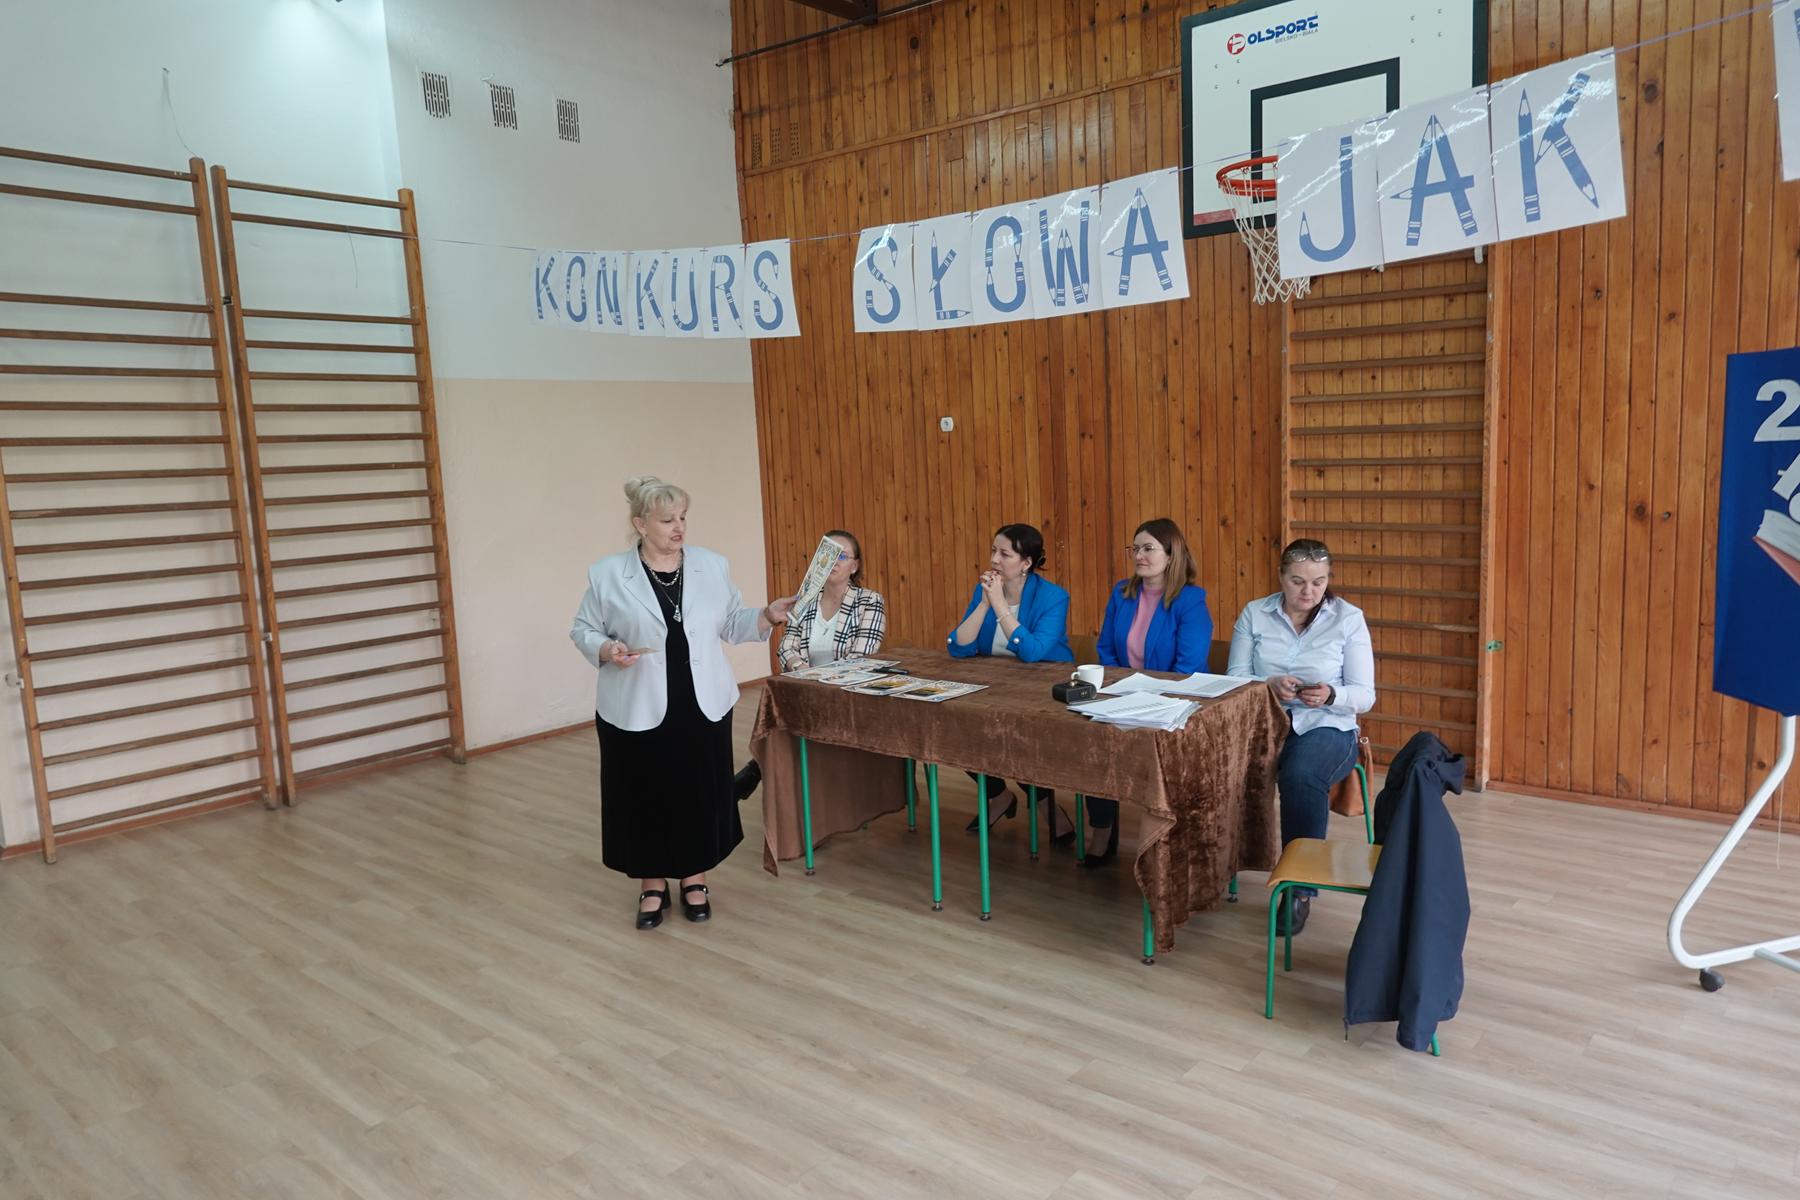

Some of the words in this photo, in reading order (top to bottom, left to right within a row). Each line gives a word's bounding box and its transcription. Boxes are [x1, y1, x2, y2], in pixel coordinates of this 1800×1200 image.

[535, 250, 783, 331] KONKURS
[864, 187, 1171, 325] SŁOWA
[1300, 72, 1600, 262] JAK
